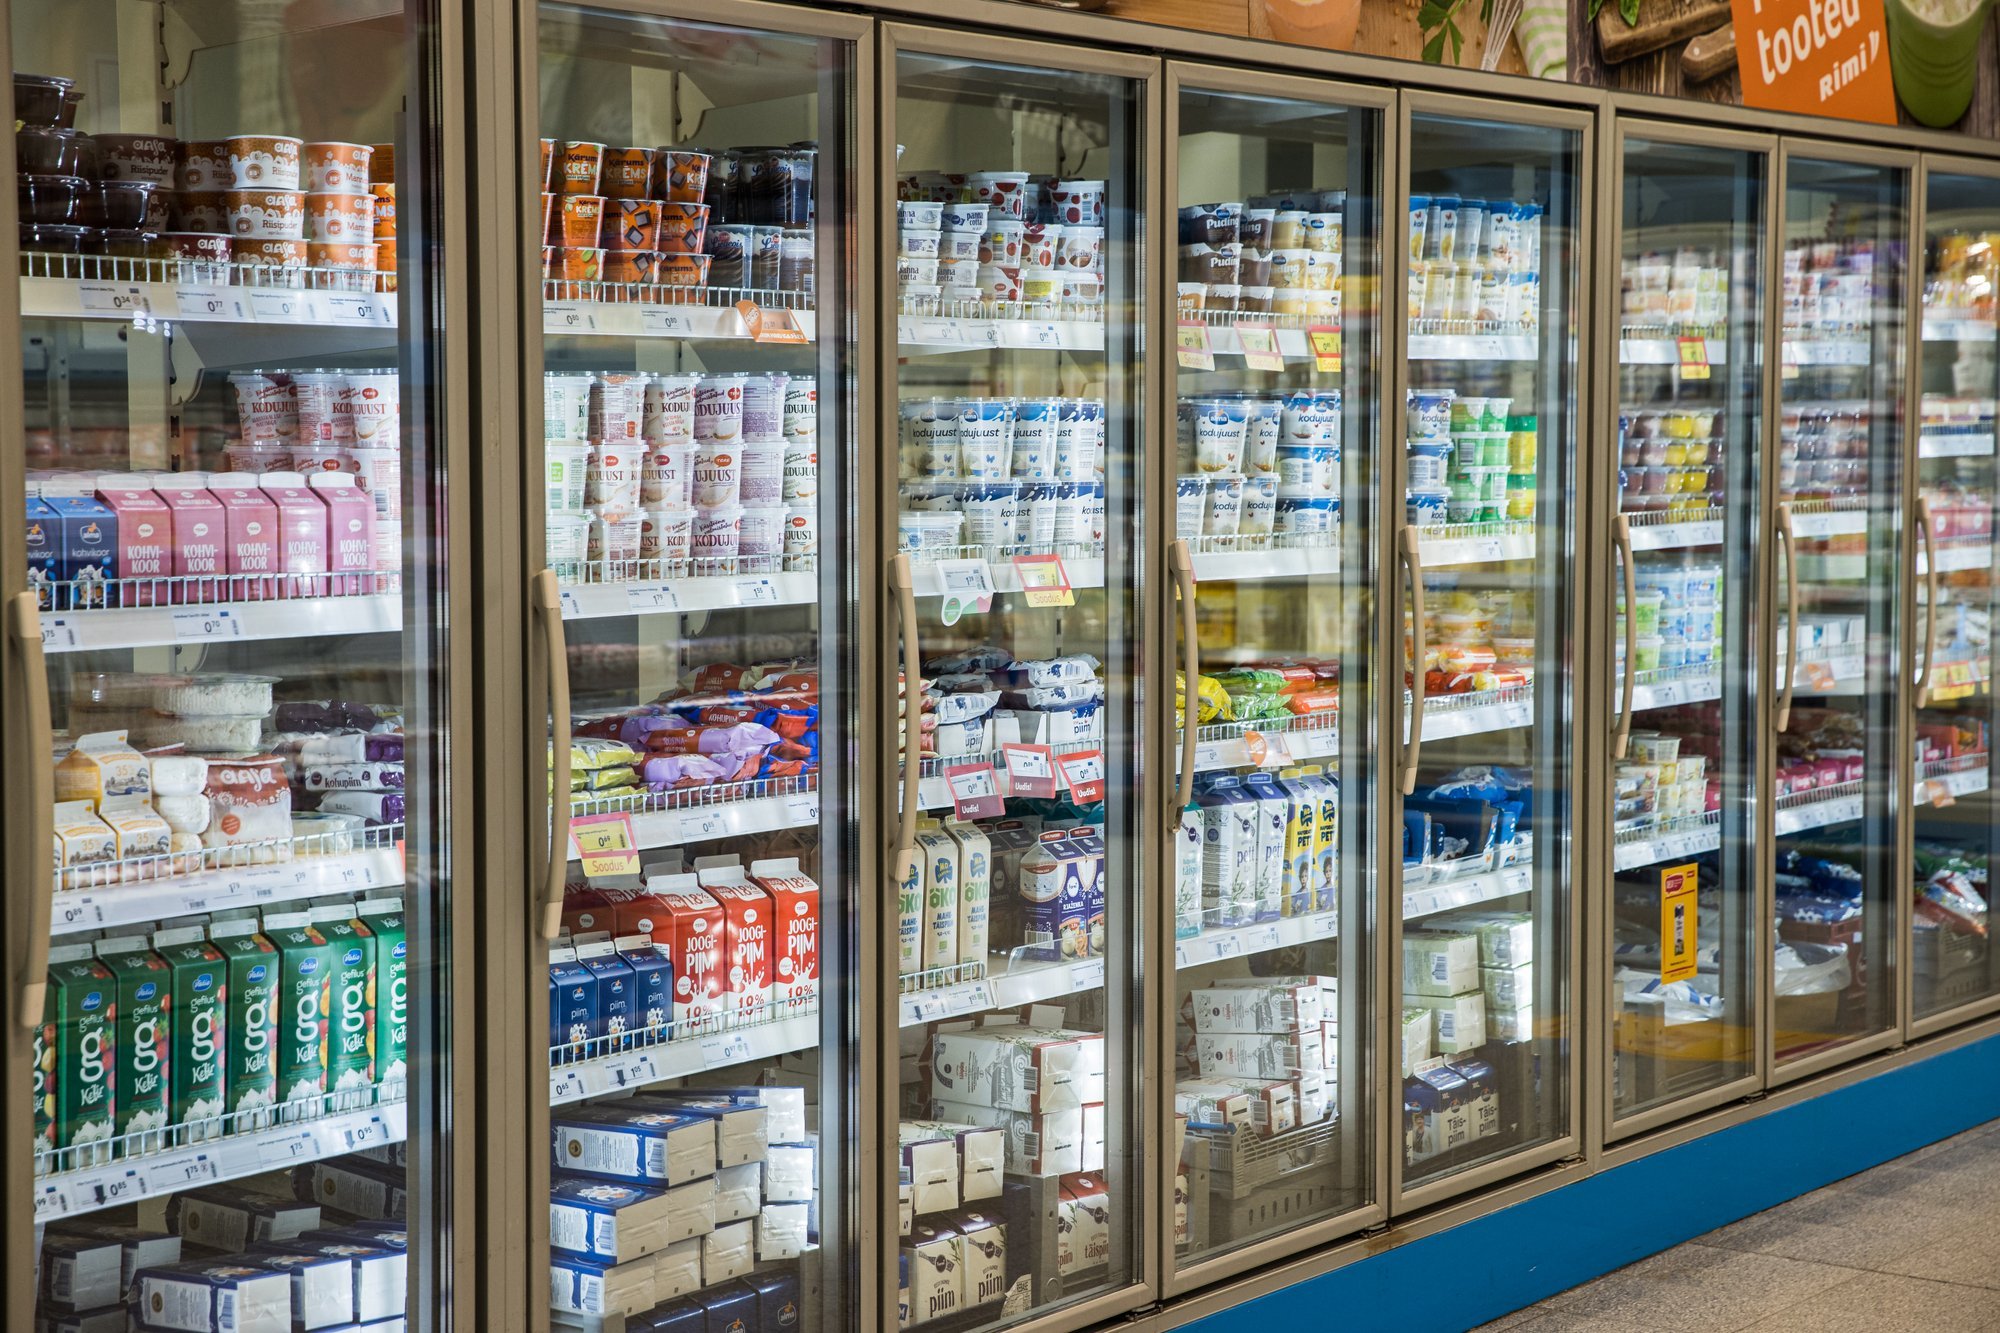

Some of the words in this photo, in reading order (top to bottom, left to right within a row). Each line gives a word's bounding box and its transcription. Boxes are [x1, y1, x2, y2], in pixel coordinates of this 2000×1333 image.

[913, 428, 957, 439] kodujuust
[127, 546, 164, 559] KOHVI-
[184, 544, 219, 558] KOHVI-
[237, 543, 272, 555] KOHVI-
[288, 541, 321, 554] KOHVI-
[339, 539, 371, 553] KOHVI-
[187, 558, 216, 572] KOOR
[241, 557, 268, 570] KOOR
[343, 552, 368, 566] KOOR
[131, 560, 160, 573] KOOR
[325, 777, 362, 788] kohupiim
[1015, 782, 1032, 791] Uudis!
[1077, 787, 1096, 798] Uudis!
[962, 804, 980, 814] Uudis!
[592, 859, 625, 872] Soodus
[929, 887, 956, 909] ÖKO
[964, 881, 989, 903] ÖKO
[788, 917, 818, 935] JOOGI-
[738, 925, 767, 943] JOOGI-
[686, 934, 718, 953] JOOGI-
[787, 932, 815, 957] PIIM
[738, 941, 764, 965] PIIM
[685, 951, 715, 976] PIIM
[648, 992, 664, 1004] piim
[610, 1000, 626, 1012] piim
[571, 1007, 588, 1020] piim
[342, 1033, 365, 1053] Kefir
[296, 1044, 319, 1064] Kefir
[245, 1053, 268, 1074] Kefir
[192, 1062, 216, 1083] Kefir
[134, 1073, 158, 1095] Kefir
[81, 1084, 105, 1106] Kefir
[1478, 1104, 1498, 1119] Täis-
[1448, 1116, 1466, 1129] Täis-
[1479, 1118, 1496, 1136] piim
[1448, 1130, 1465, 1147] piim
[979, 1273, 1003, 1303] piim
[930, 1287, 955, 1318] piim
